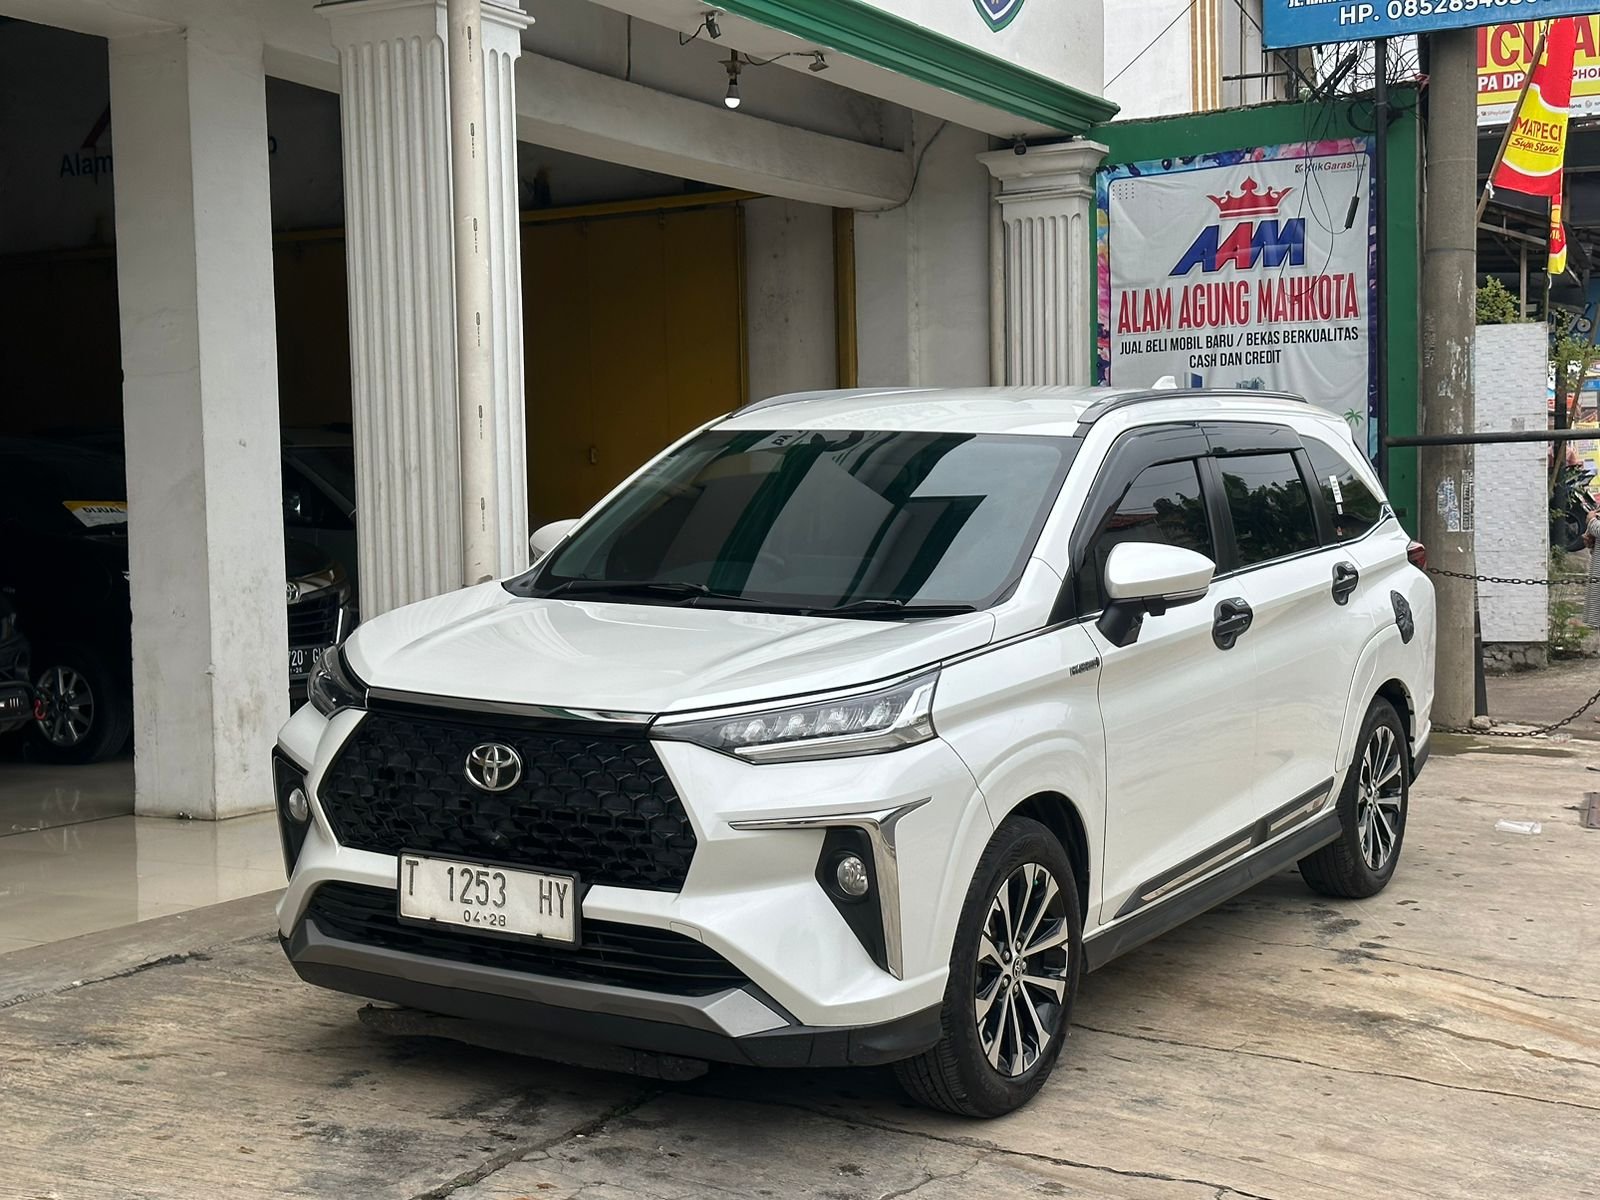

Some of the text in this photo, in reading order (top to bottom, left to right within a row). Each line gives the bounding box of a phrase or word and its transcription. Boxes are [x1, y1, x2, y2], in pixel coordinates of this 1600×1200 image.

[1340, 3, 1380, 25] HP.
[1168, 217, 1306, 277] AAM
[1117, 273, 1359, 334] ALAM AGUNG MAHKOTA
[1120, 326, 1359, 355] JUAL BELI MOBIL BARU / BEKAS BERKUALITAS
[1189, 350, 1281, 368] CASH DAN CREDIT
[406, 859, 568, 918] T 1253 HY
